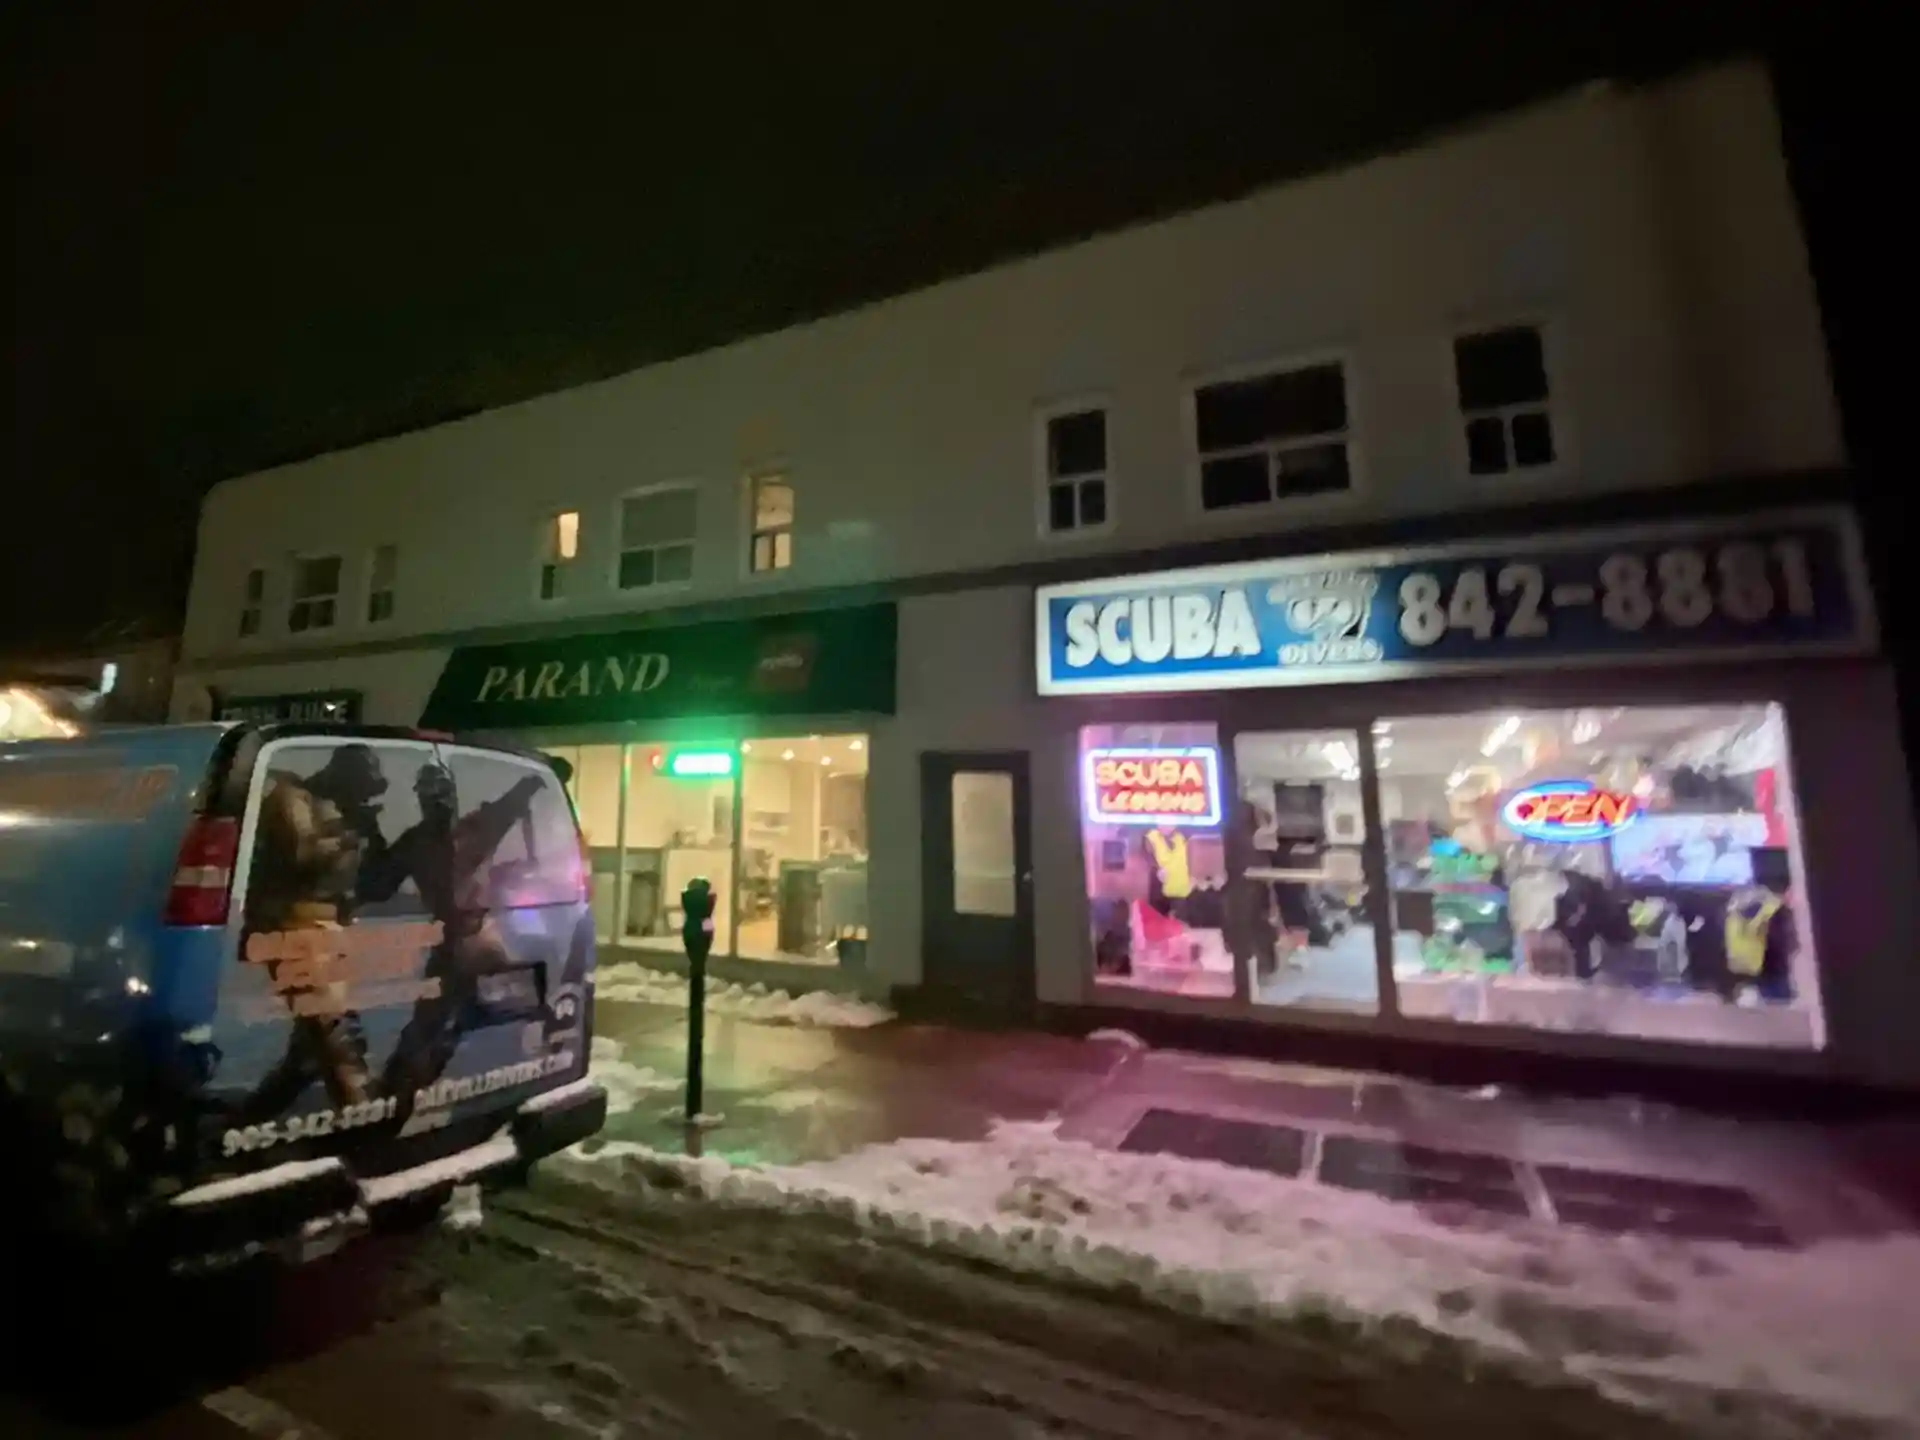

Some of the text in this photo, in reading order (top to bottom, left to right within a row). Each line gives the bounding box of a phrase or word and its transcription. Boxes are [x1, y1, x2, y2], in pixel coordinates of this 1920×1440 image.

[1065, 588, 1262, 669] SCUBA
[475, 653, 670, 703] PARAND
[1096, 759, 1204, 787] SCUBA
[1511, 792, 1635, 826] OPEN
